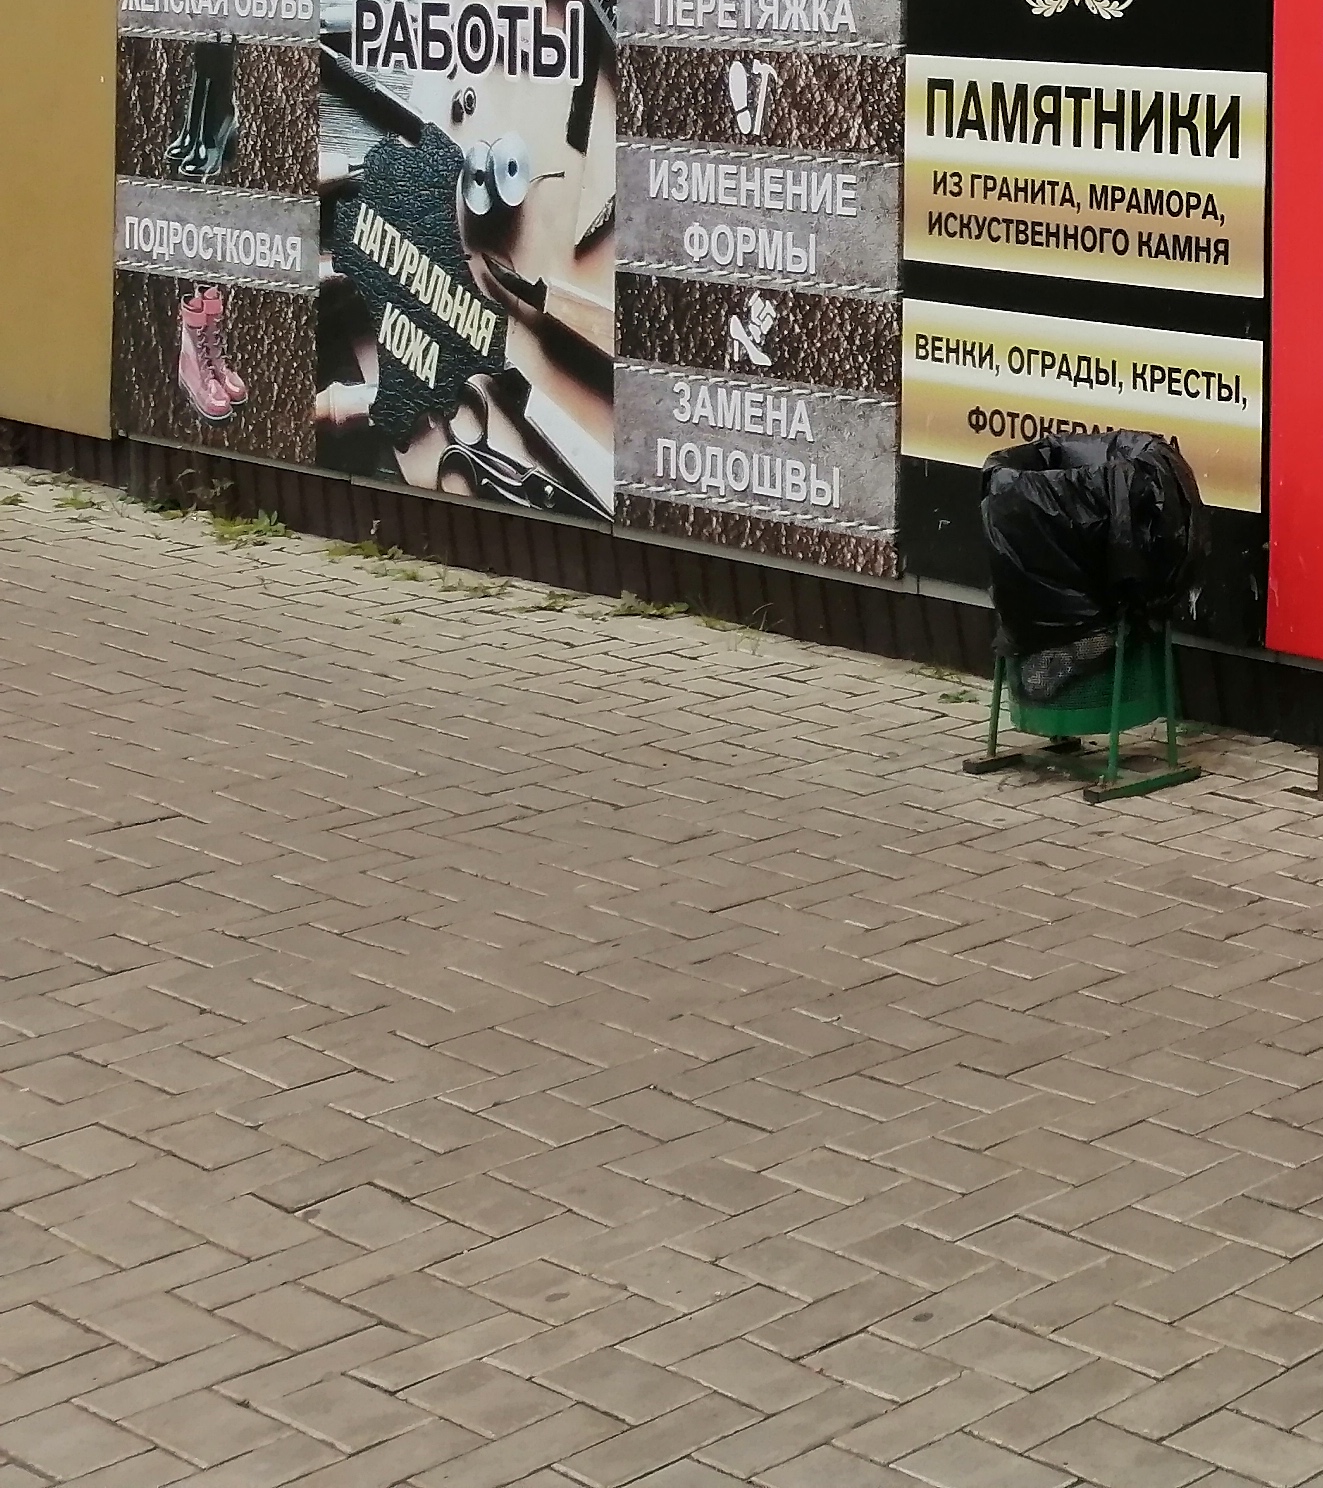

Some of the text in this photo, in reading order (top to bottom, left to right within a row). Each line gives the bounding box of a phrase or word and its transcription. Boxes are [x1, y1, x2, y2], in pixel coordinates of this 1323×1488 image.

[353, 0, 583, 82] РАБОТЫ
[924, 77, 1242, 160] ПАМЯТНИКИ
[649, 161, 859, 216] ИЗМЕНЕНИЕ
[932, 172, 1226, 225] ИЗ ГРАНИТА, МРАМОРА,
[124, 216, 303, 272] ПОДРОСТКОВАЯ
[684, 225, 818, 275] ФОРМЫ
[927, 210, 1231, 267] ИСКУСТВЕННОГО КАМНЯ
[351, 206, 497, 357] НАТУРАЛЬНАЯ
[379, 303, 440, 390] КОЖА
[915, 334, 1247, 410] ВЕНКИ, ОГРАДЫ, КРЕСТЫ,
[673, 380, 814, 443] ЗАМЕНА
[656, 439, 841, 510] ПОДОШВЫ
